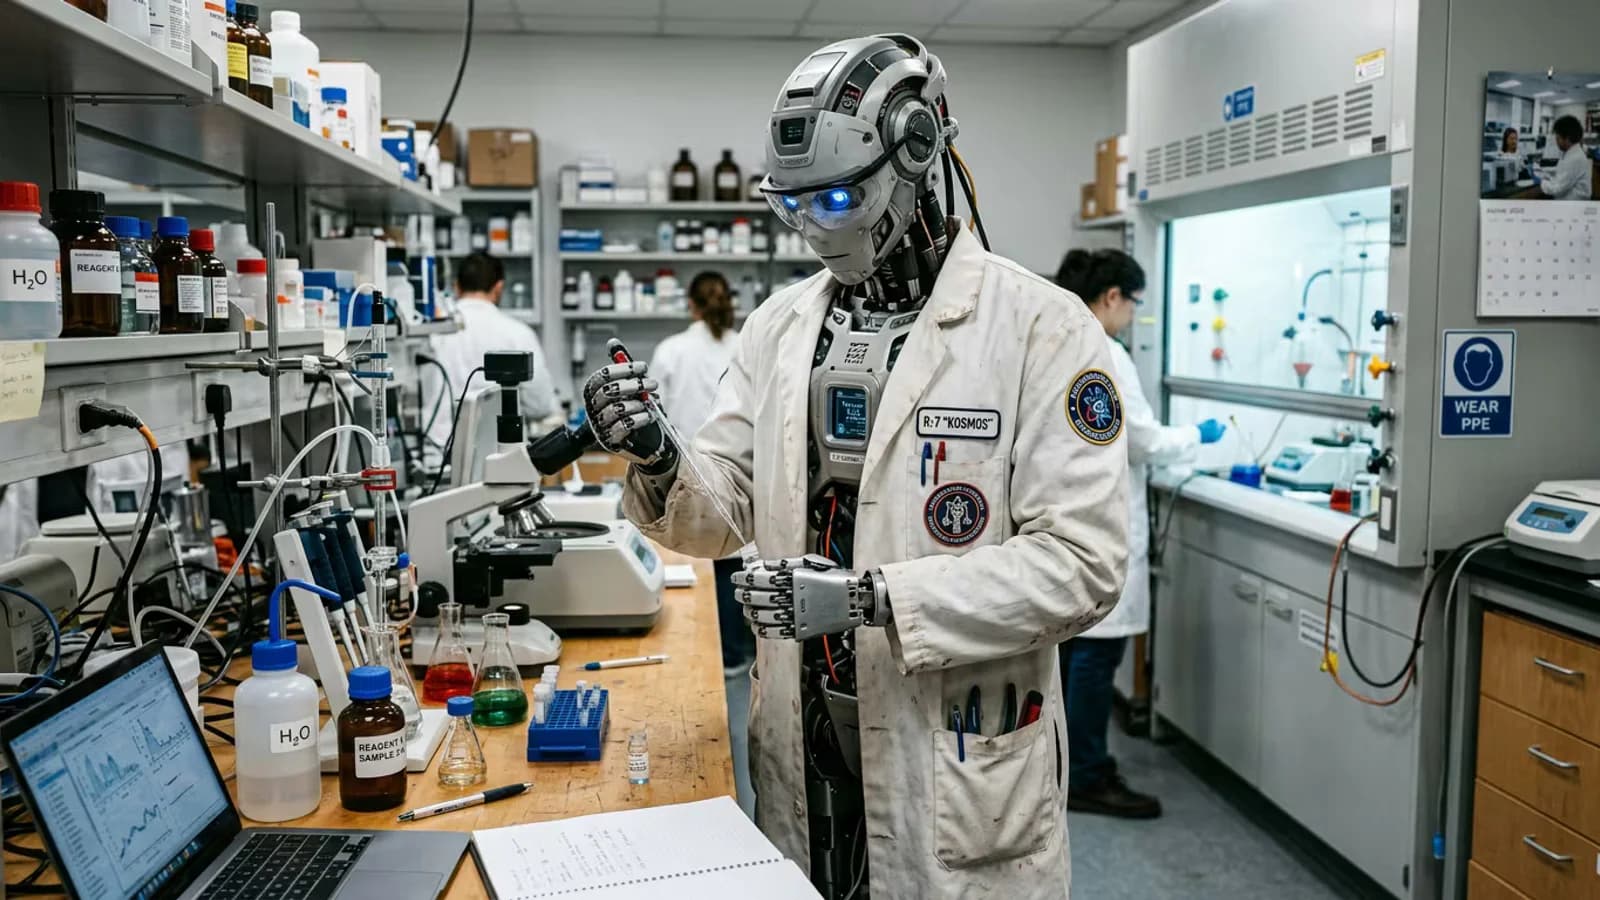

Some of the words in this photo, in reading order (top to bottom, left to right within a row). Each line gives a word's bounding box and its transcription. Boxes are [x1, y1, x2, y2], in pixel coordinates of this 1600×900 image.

[12, 269, 47, 290] H2O
[1454, 400, 1499, 414] WEAR
[923, 415, 941, 428] R:7
[943, 416, 993, 430] "KOSMOS"
[1461, 417, 1490, 431] PPE
[280, 725, 310, 746] H2O
[359, 750, 395, 762] SAMPLE
